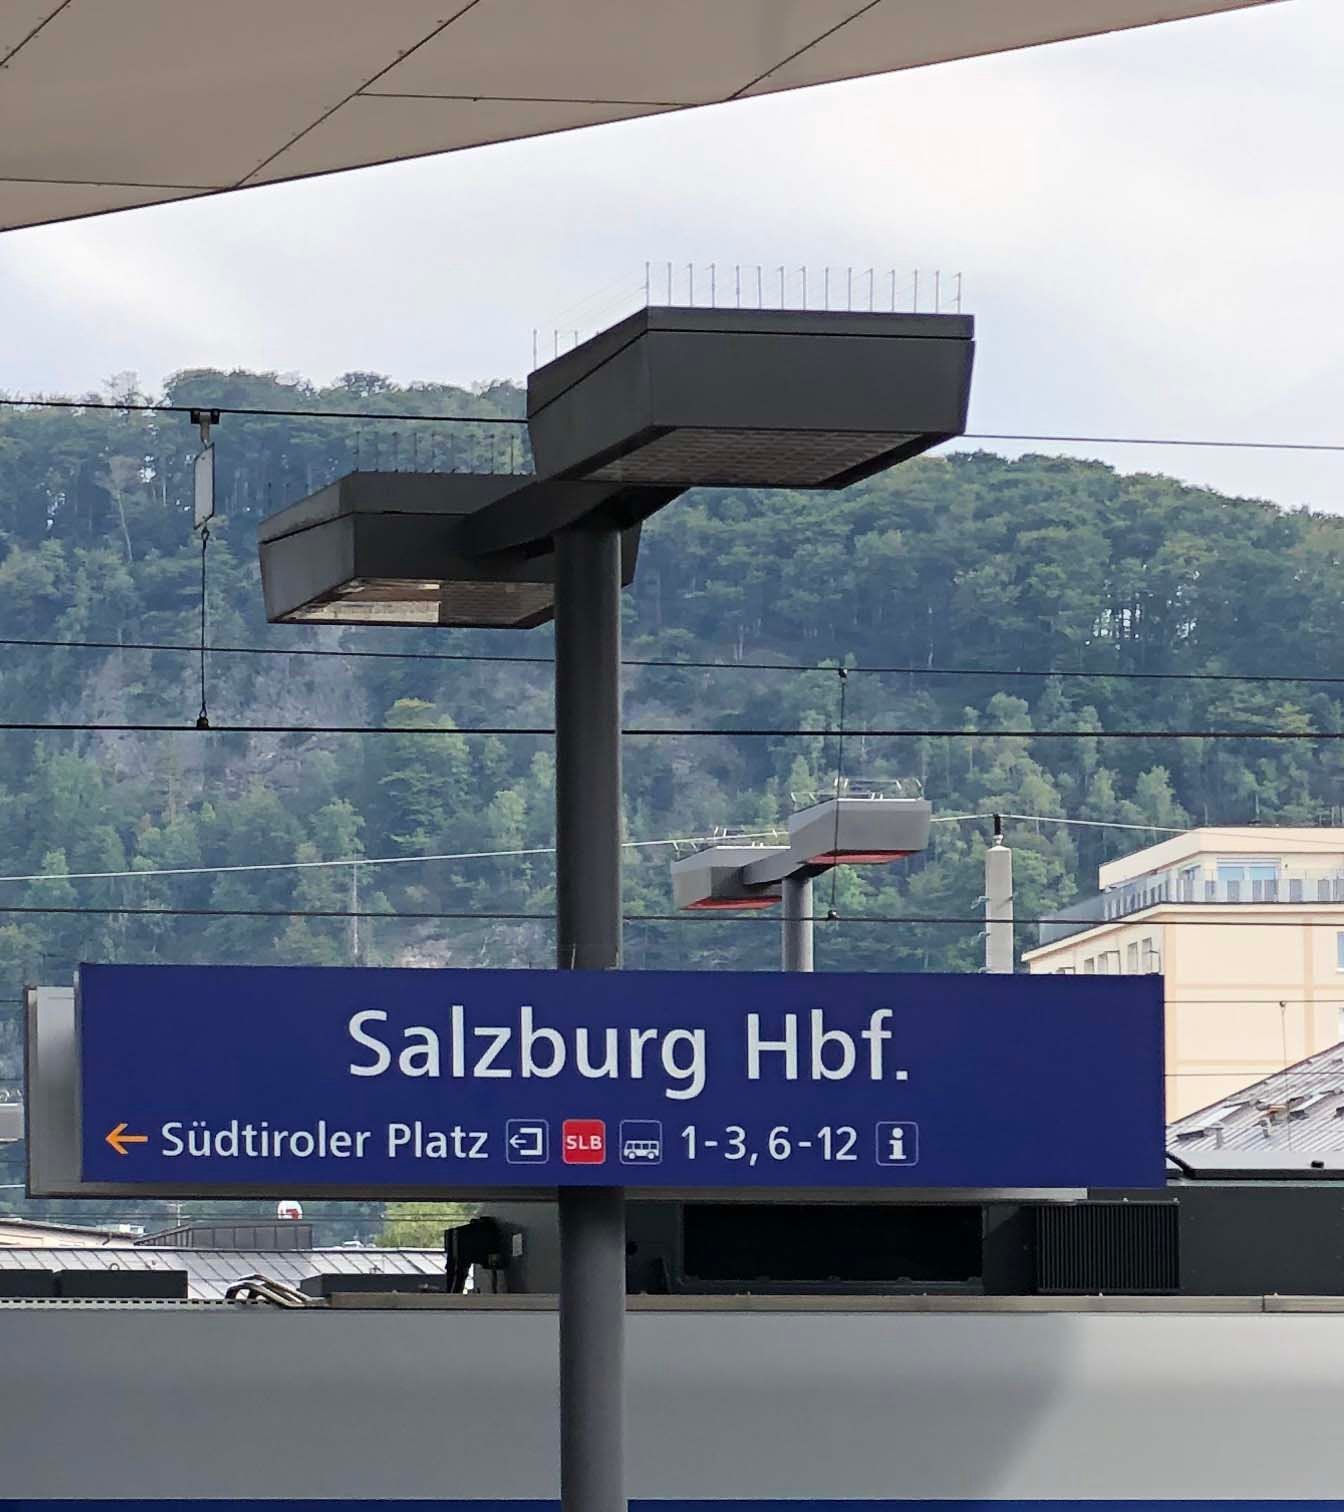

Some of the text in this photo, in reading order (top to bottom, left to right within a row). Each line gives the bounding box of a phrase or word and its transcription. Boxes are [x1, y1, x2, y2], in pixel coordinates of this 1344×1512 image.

[348, 1005, 908, 1100] Salzburg Hbf.
[161, 1119, 371, 1158] Südtiroler
[388, 1120, 489, 1159] Platz
[566, 1135, 603, 1150] SLB
